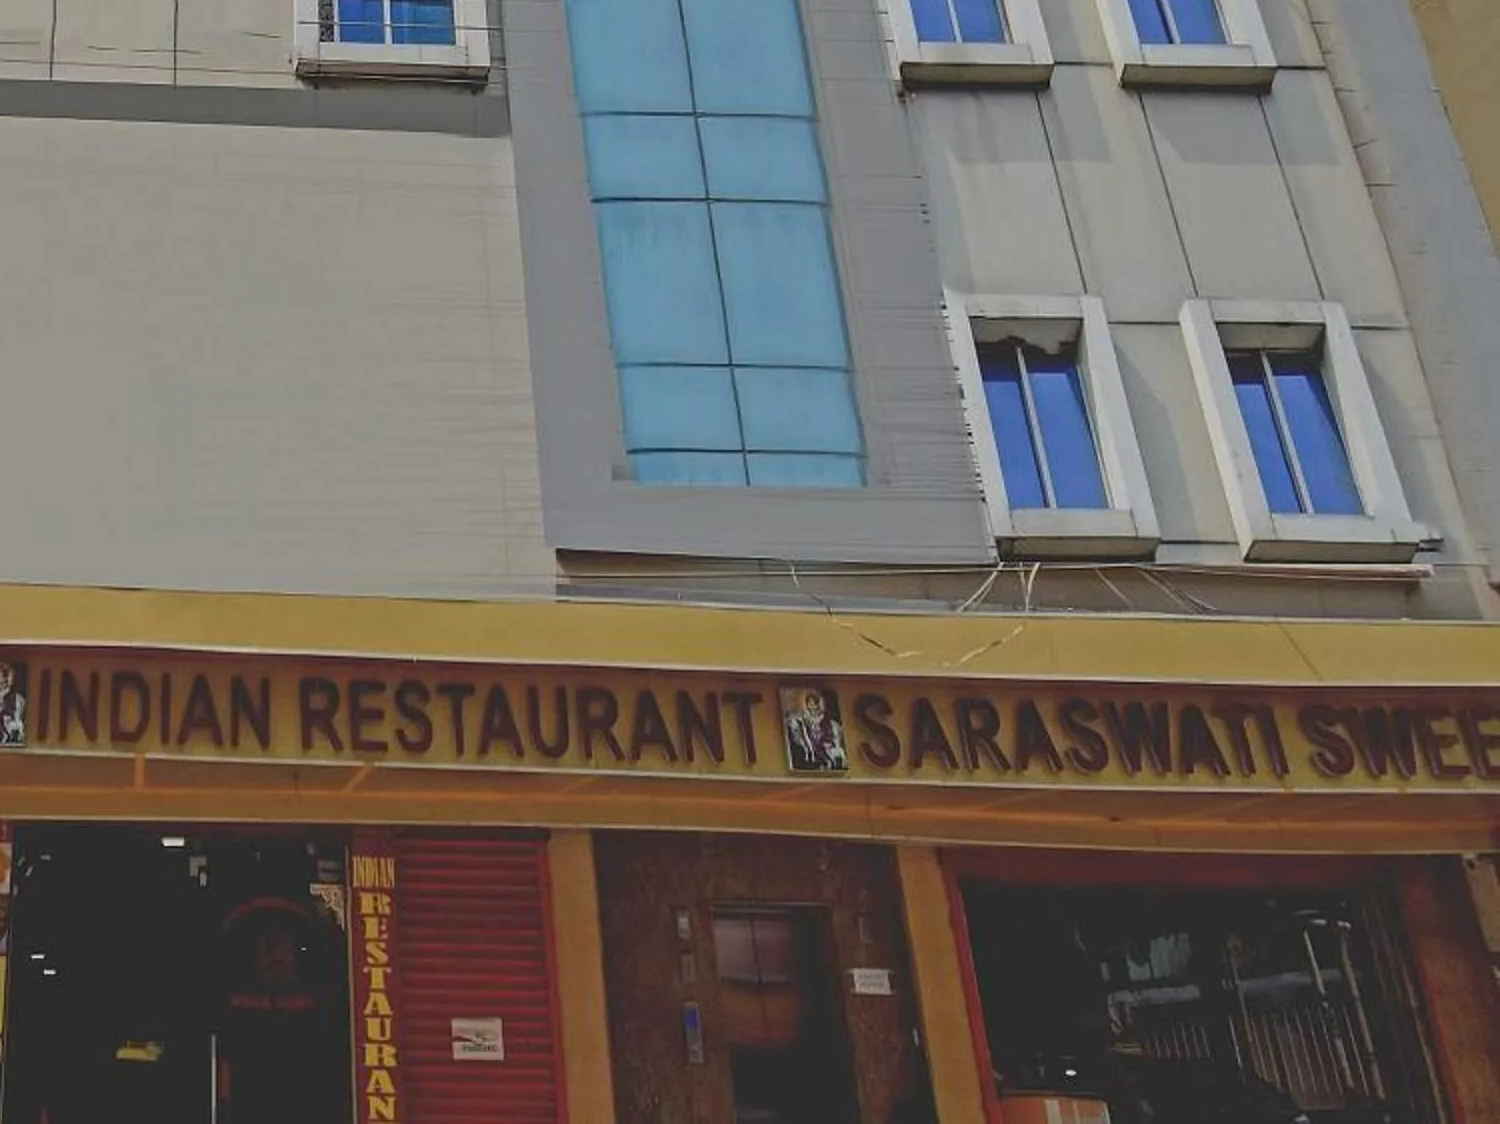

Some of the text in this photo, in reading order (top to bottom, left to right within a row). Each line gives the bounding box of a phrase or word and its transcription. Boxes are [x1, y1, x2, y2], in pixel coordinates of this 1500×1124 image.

[36, 669, 763, 768] INDIAN RESTAURANT
[854, 693, 1289, 776] SARASWATI
[352, 856, 395, 888] INDIAN
[358, 891, 397, 1124] RESTAURAN
